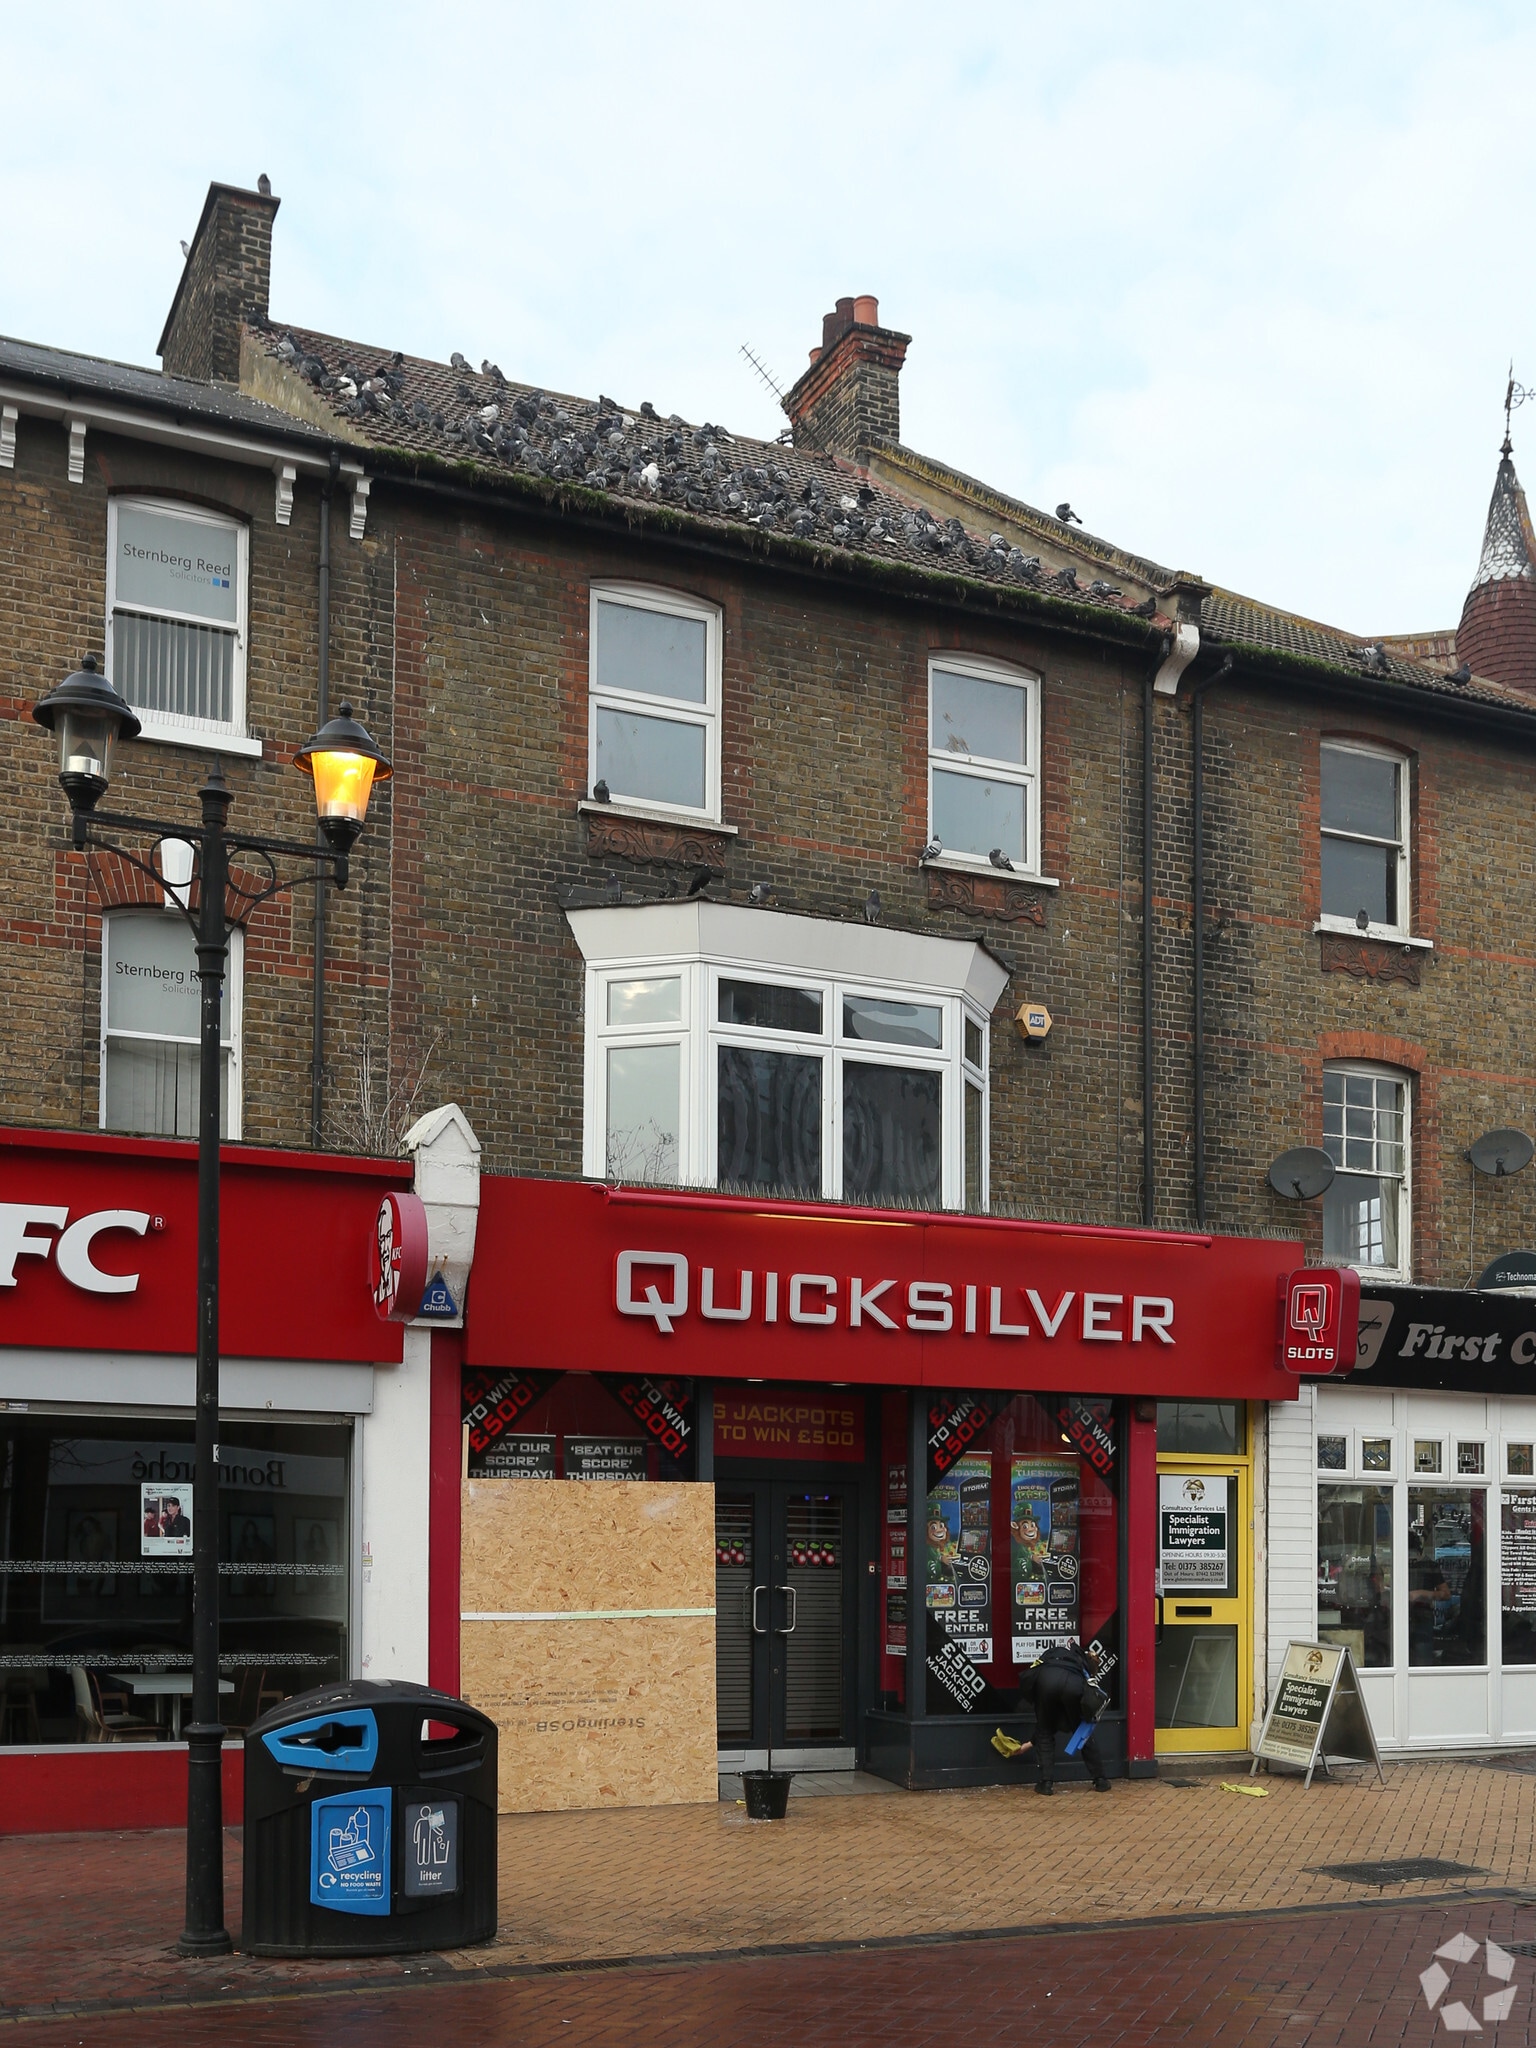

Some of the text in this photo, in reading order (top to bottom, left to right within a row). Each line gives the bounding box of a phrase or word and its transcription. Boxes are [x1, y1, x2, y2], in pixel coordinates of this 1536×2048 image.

[123, 543, 231, 576] Sternberg Reed
[169, 569, 211, 585] Solicitors
[115, 961, 184, 984] Sternberg
[1030, 1014, 1045, 1026] ADT
[614, 1250, 1177, 1344] QUICKSILVER
[423, 1303, 452, 1312] Chubb
[1398, 1323, 1536, 1365] First C
[1287, 1347, 1334, 1360] SLOTS
[462, 1371, 520, 1429] TO WIN
[640, 1377, 692, 1437] TO WIN
[469, 1376, 541, 1454] £500!
[619, 1383, 689, 1459] £500!
[733, 1404, 855, 1427] JACKPOTS
[928, 1397, 976, 1448] TO WIN
[1074, 1401, 1117, 1456] TO WIN
[718, 1425, 855, 1446] TO WIN £500
[933, 1401, 993, 1472] £500!
[1056, 1407, 1114, 1475] £500!
[519, 1443, 552, 1454] OUR
[613, 1446, 643, 1457] OUR
[1014, 1469, 1079, 1478] TUESDAYS!
[1161, 1504, 1193, 1512] Consultancy
[1169, 1514, 1209, 1526] Specialist
[1168, 1525, 1220, 1537] Immigration
[1169, 1536, 1206, 1547] Lawyers
[1164, 1562, 1224, 1571] Tel: 01375 385267
[934, 1609, 980, 1623] FREE
[1025, 1607, 1069, 1621] FREE
[945, 1623, 989, 1633] ENTER!
[1015, 1620, 1077, 1631] TO ENTER!
[1035, 1639, 1057, 1650] FUN
[940, 1641, 986, 1694] £500
[935, 1654, 977, 1699] JACKPOT
[925, 1655, 974, 1713] MACHINES!
[1286, 1681, 1318, 1696] Specialist
[1282, 1692, 1323, 1707] Immigration
[1279, 1702, 1309, 1716] Lawyers
[1281, 1721, 1297, 1731] 01375
[340, 1871, 381, 1881] recycling
[419, 1870, 442, 1881] litter
